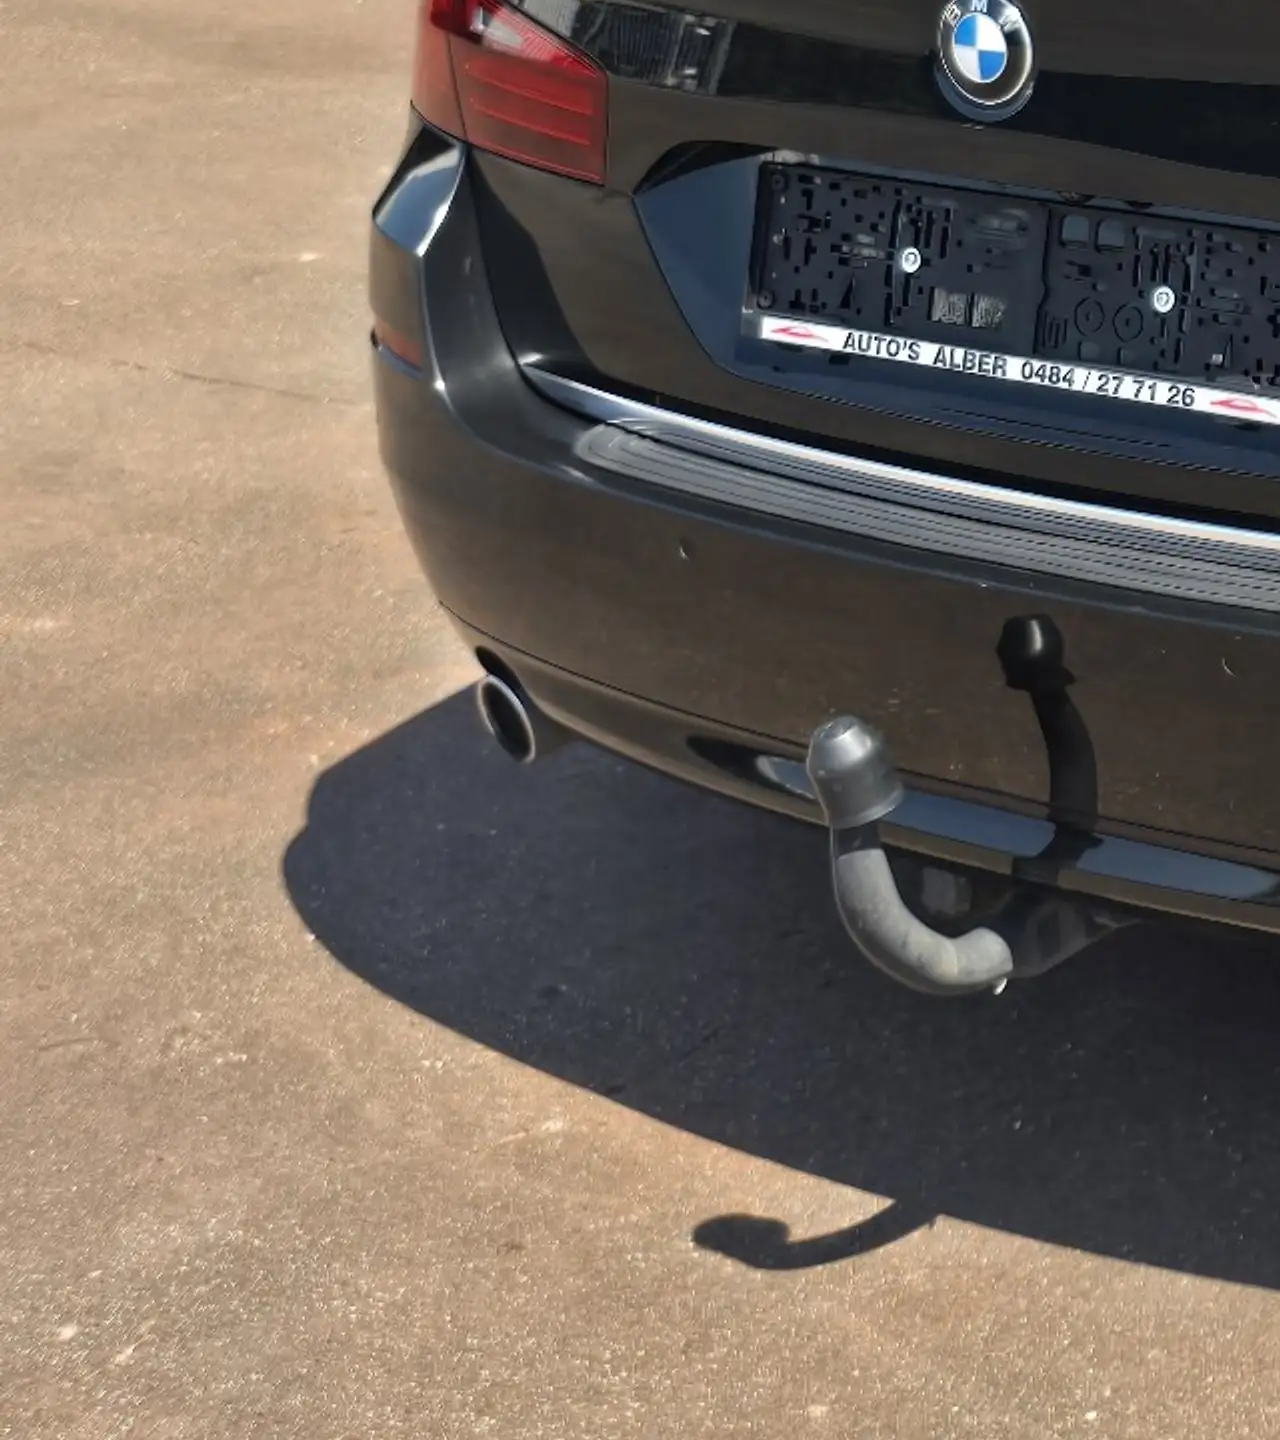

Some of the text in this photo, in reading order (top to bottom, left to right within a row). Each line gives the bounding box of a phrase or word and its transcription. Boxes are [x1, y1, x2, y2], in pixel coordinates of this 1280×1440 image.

[841, 331, 922, 362] AUTO'S
[932, 349, 1008, 378] ALBER
[1020, 360, 1076, 389] 0484
[1095, 373, 1126, 397] 27
[1132, 378, 1158, 402] 71
[1165, 384, 1197, 408] 26
